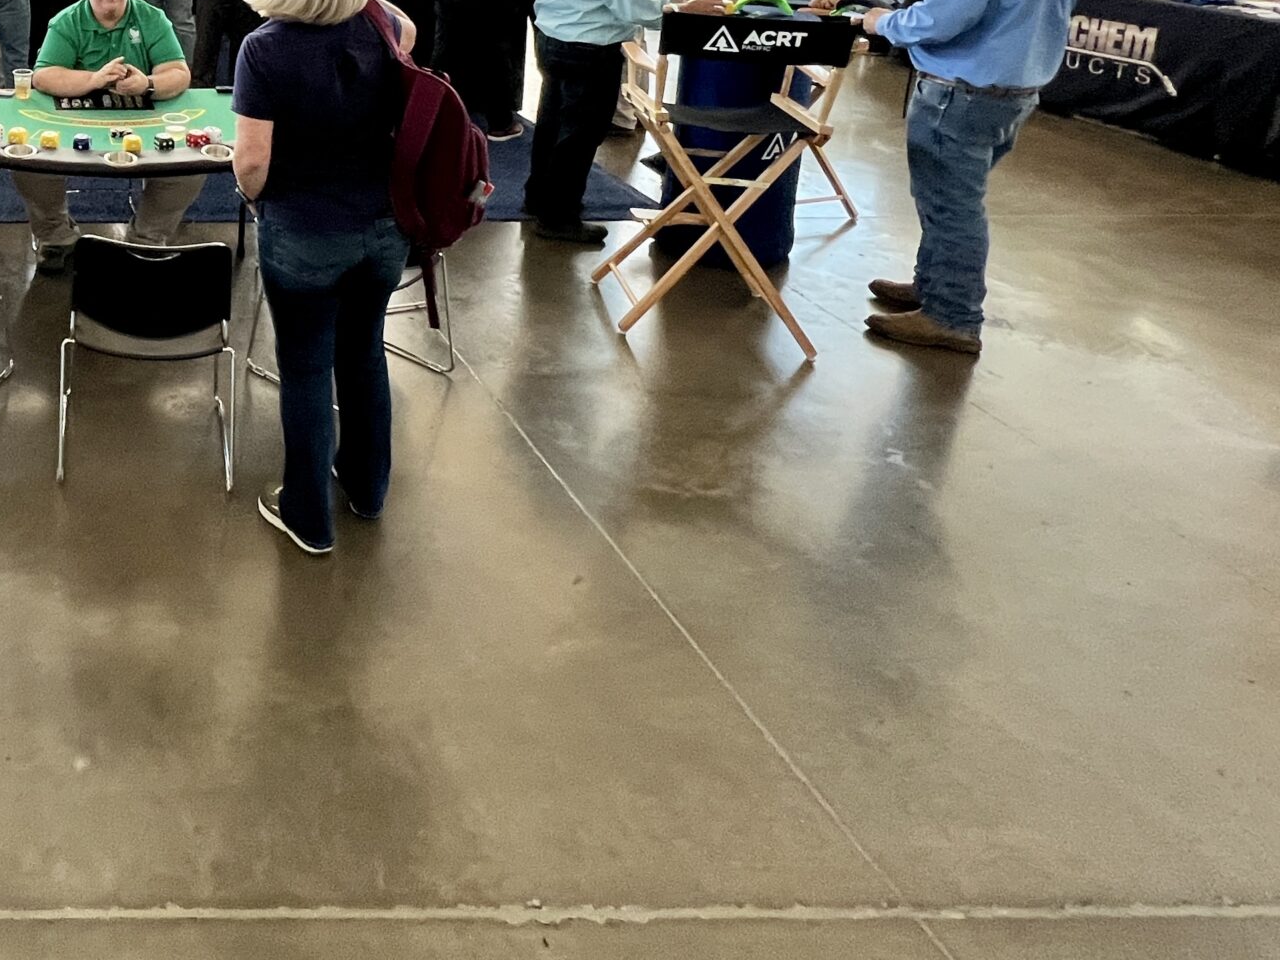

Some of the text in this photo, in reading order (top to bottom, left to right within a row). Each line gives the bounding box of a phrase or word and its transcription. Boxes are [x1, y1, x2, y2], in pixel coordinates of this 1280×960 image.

[741, 44, 771, 52] PACIFIC
[742, 30, 809, 48] ACRT
[1069, 15, 1158, 60] CHEM
[1066, 51, 1151, 85] UCTS
